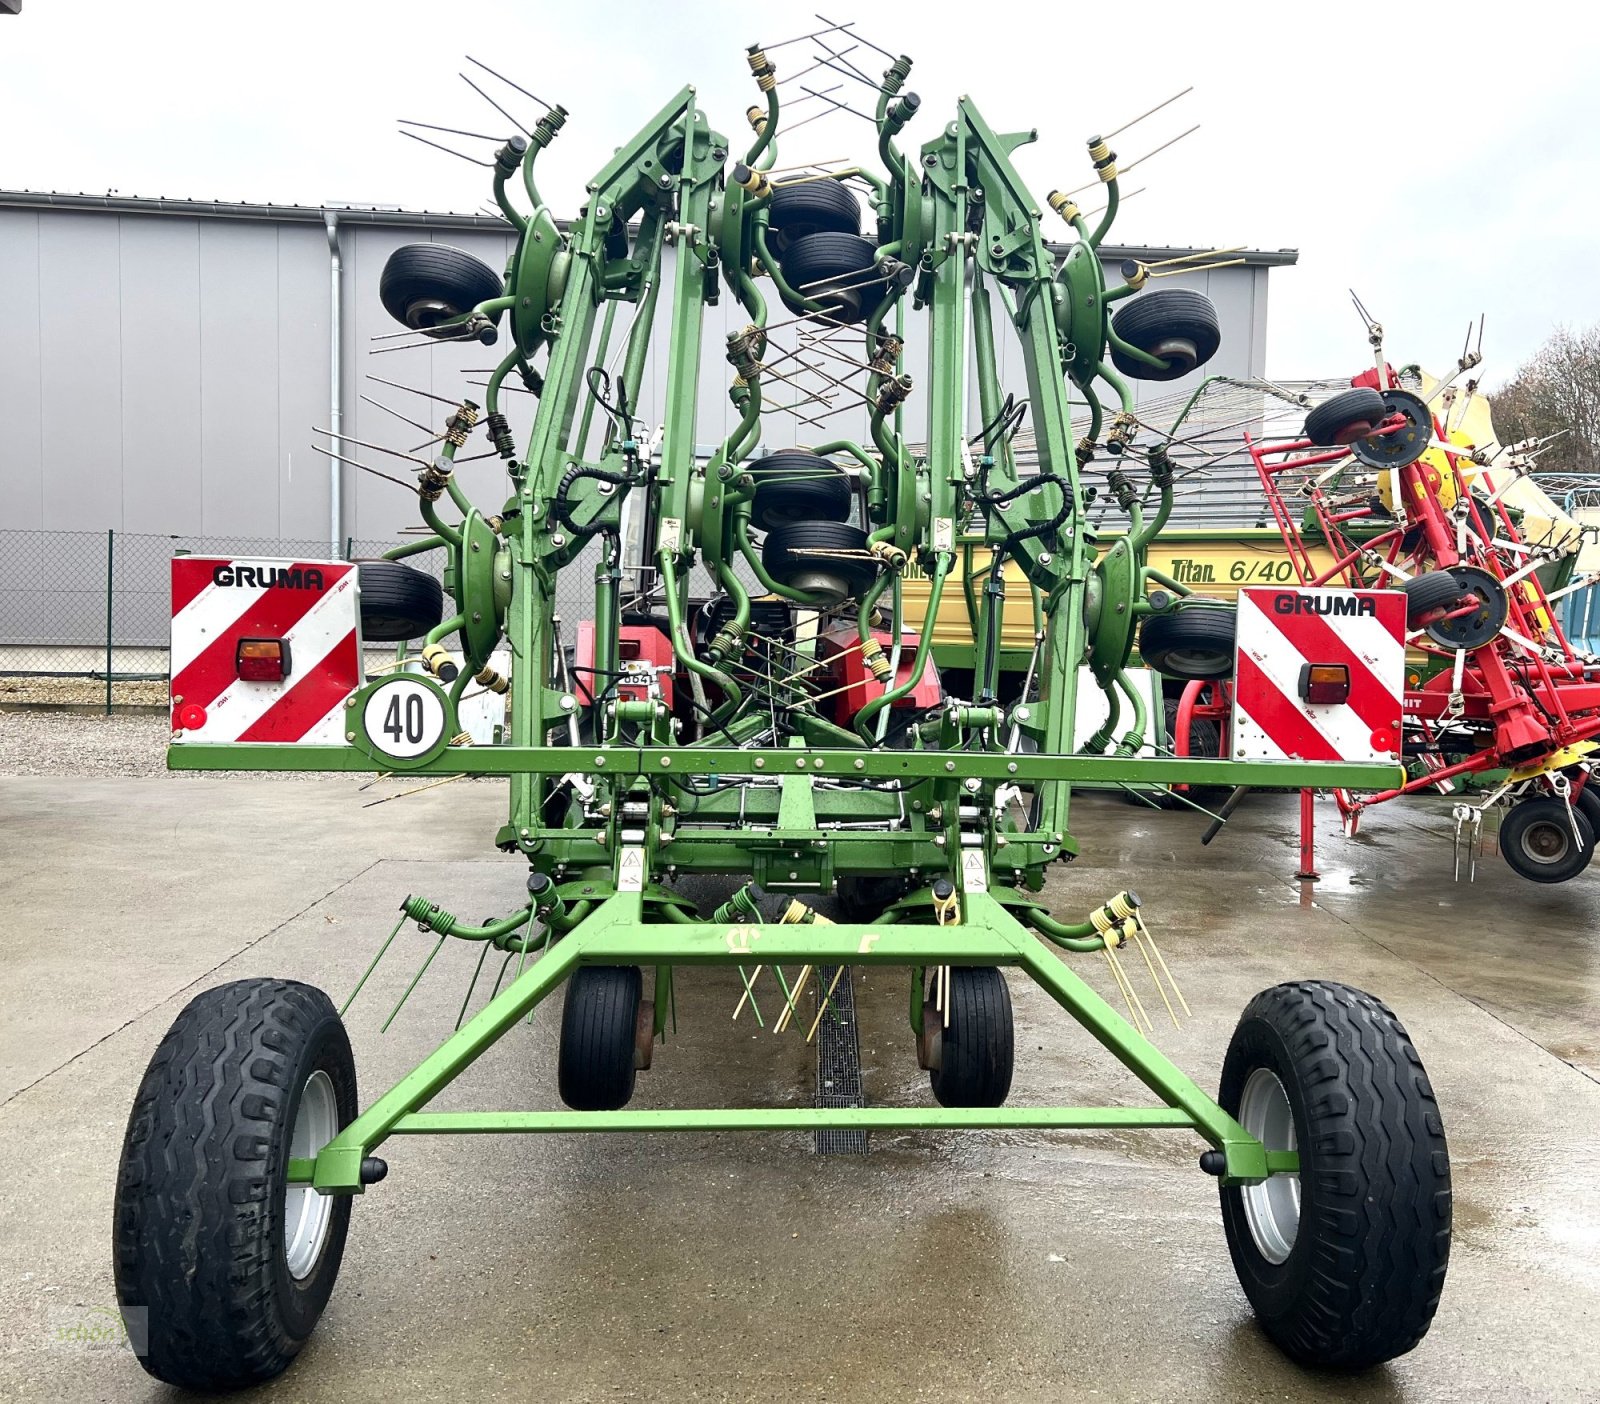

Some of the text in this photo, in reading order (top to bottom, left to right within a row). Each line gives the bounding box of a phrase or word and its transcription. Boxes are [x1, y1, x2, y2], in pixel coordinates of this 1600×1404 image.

[213, 566, 323, 590] GRUMA
[1229, 560, 1293, 582] 6/40
[1275, 594, 1376, 617] GRUMA
[383, 694, 423, 743] 40
